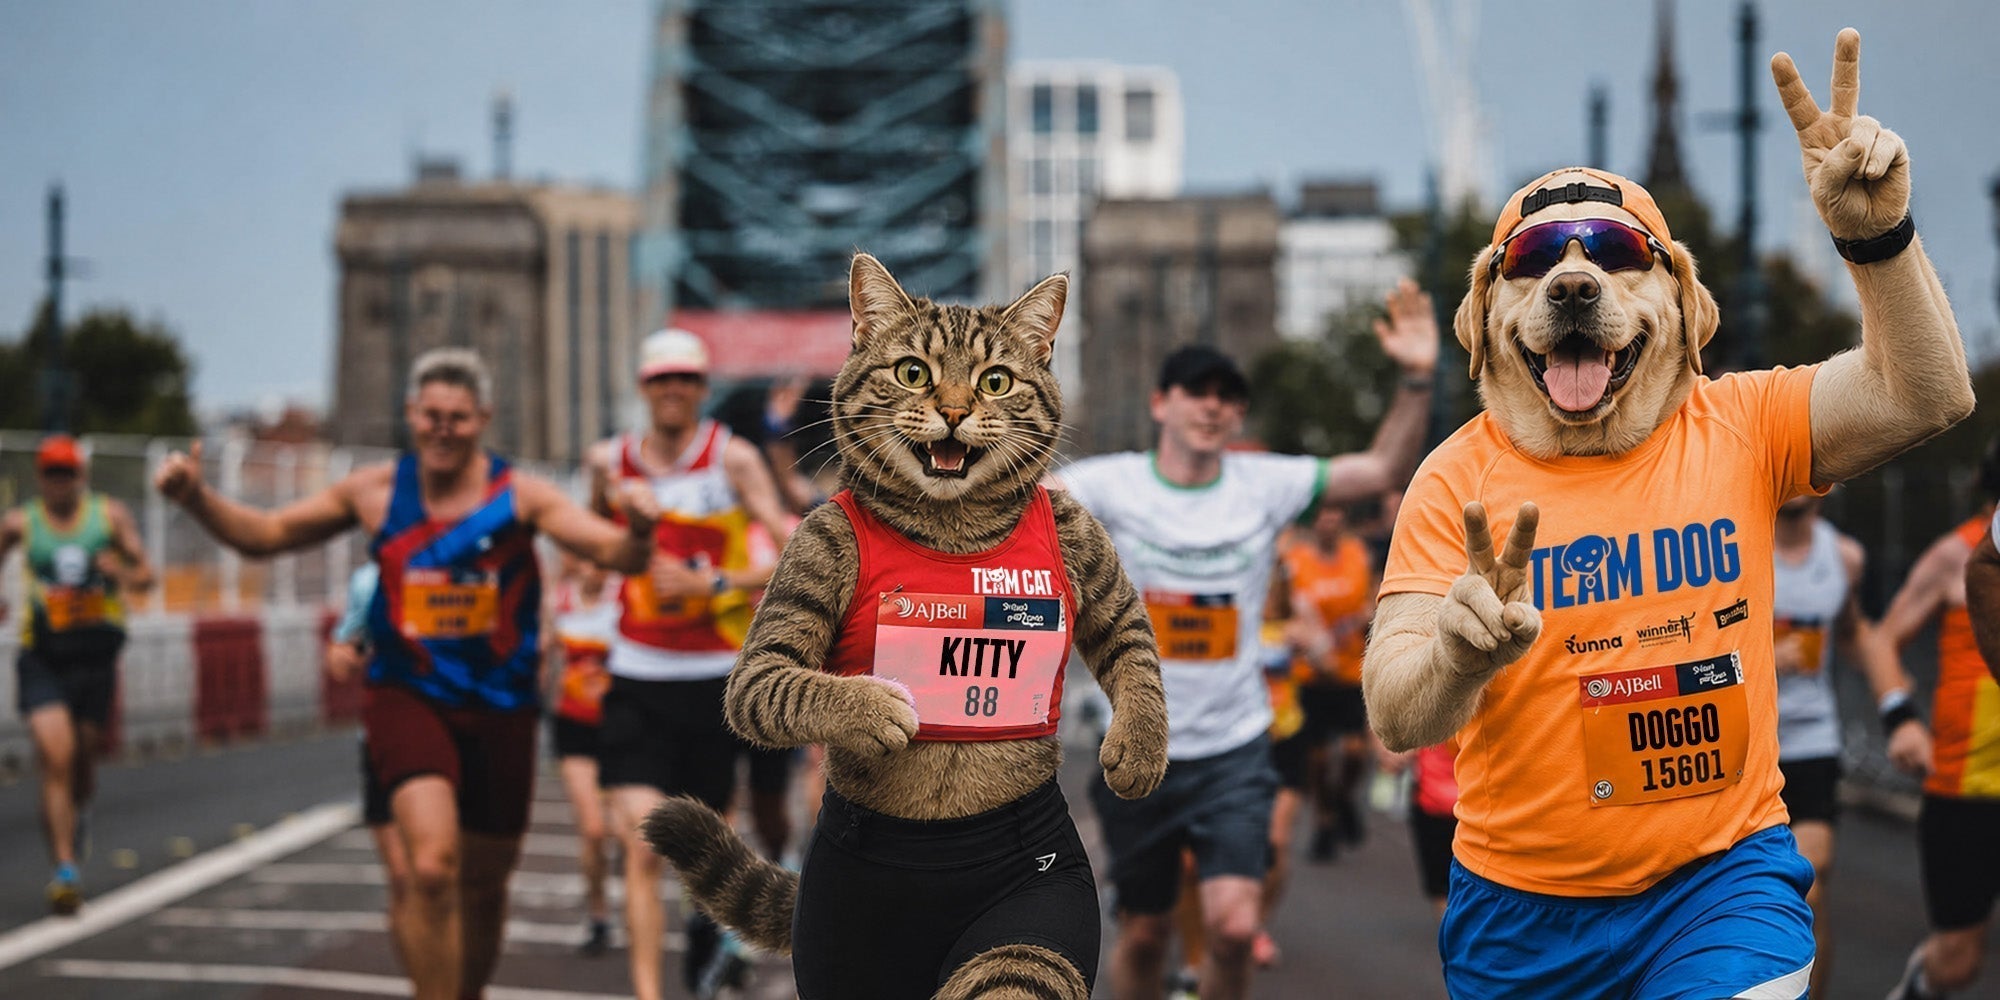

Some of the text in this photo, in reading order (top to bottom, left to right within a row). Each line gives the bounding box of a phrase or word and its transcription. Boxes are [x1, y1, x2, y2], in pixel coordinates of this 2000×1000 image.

[971, 566, 1053, 596] TEAM CAT
[1529, 518, 1742, 611] TEAM DOG
[939, 636, 1027, 679] KITTY
[964, 685, 999, 717] 88
[1628, 702, 1721, 752] DOGGO
[1641, 749, 1726, 793] 15601
